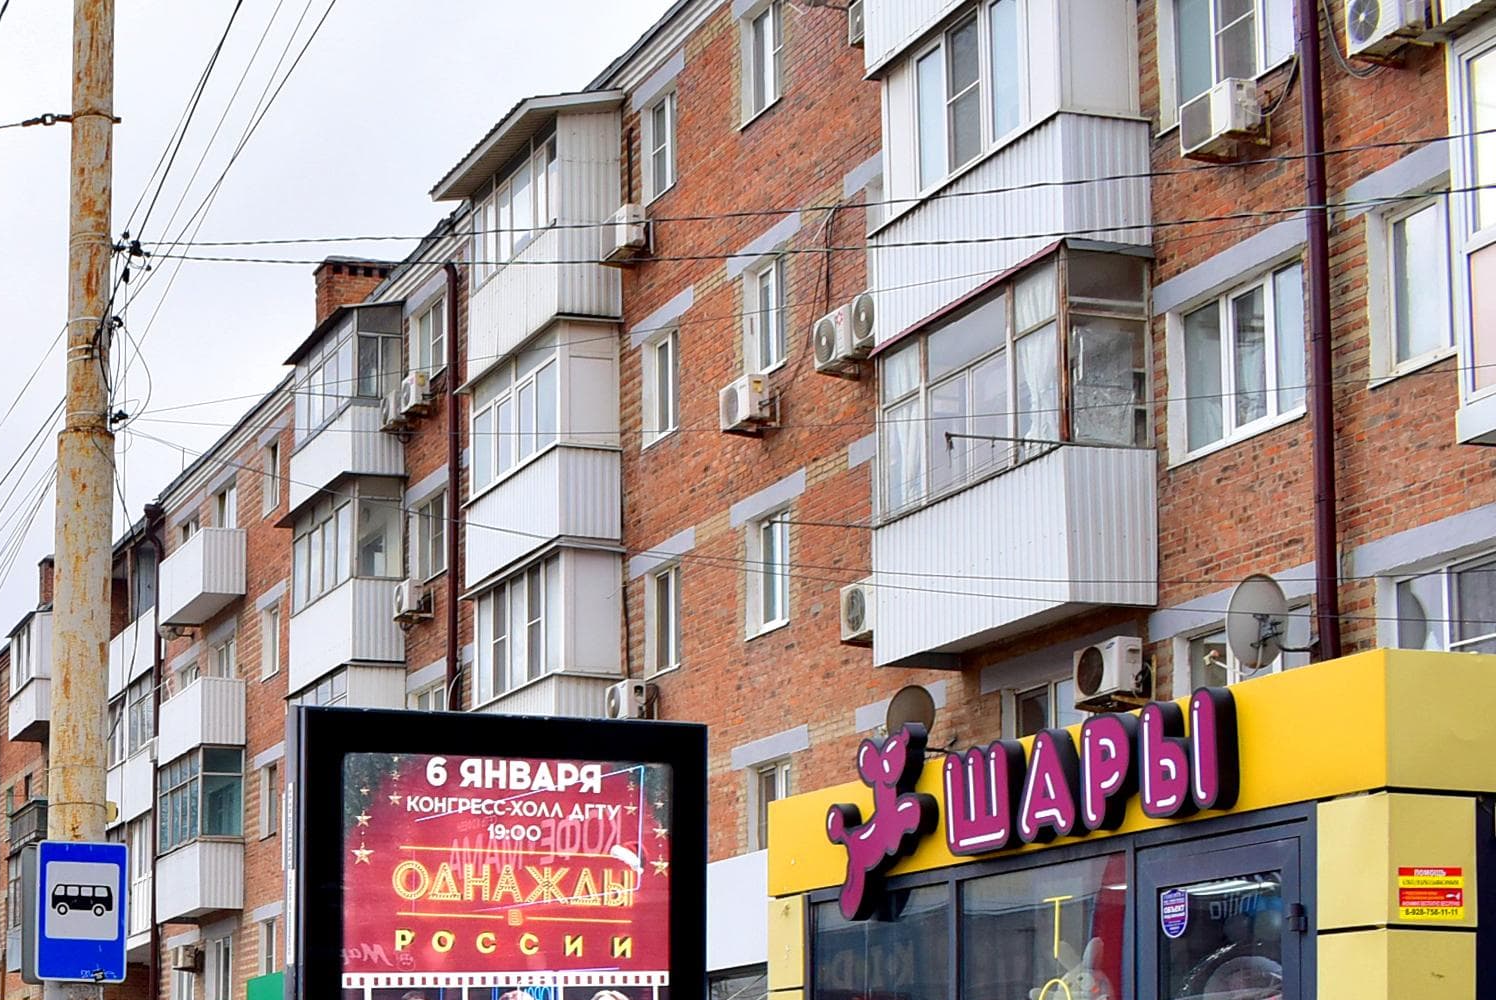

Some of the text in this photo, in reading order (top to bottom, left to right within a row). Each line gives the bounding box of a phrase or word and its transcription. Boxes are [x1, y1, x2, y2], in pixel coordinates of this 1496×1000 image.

[425, 756, 602, 794] 6 ЯНВАРЯ
[944, 687, 1238, 856] ШАРЫ
[406, 795, 621, 822] КОНГРЕСС-ХОЛЛ ДГТУ
[487, 824, 542, 841] 19:00
[392, 860, 634, 908] ОДНАЖДЫ
[394, 929, 633, 959] РОССИИ
